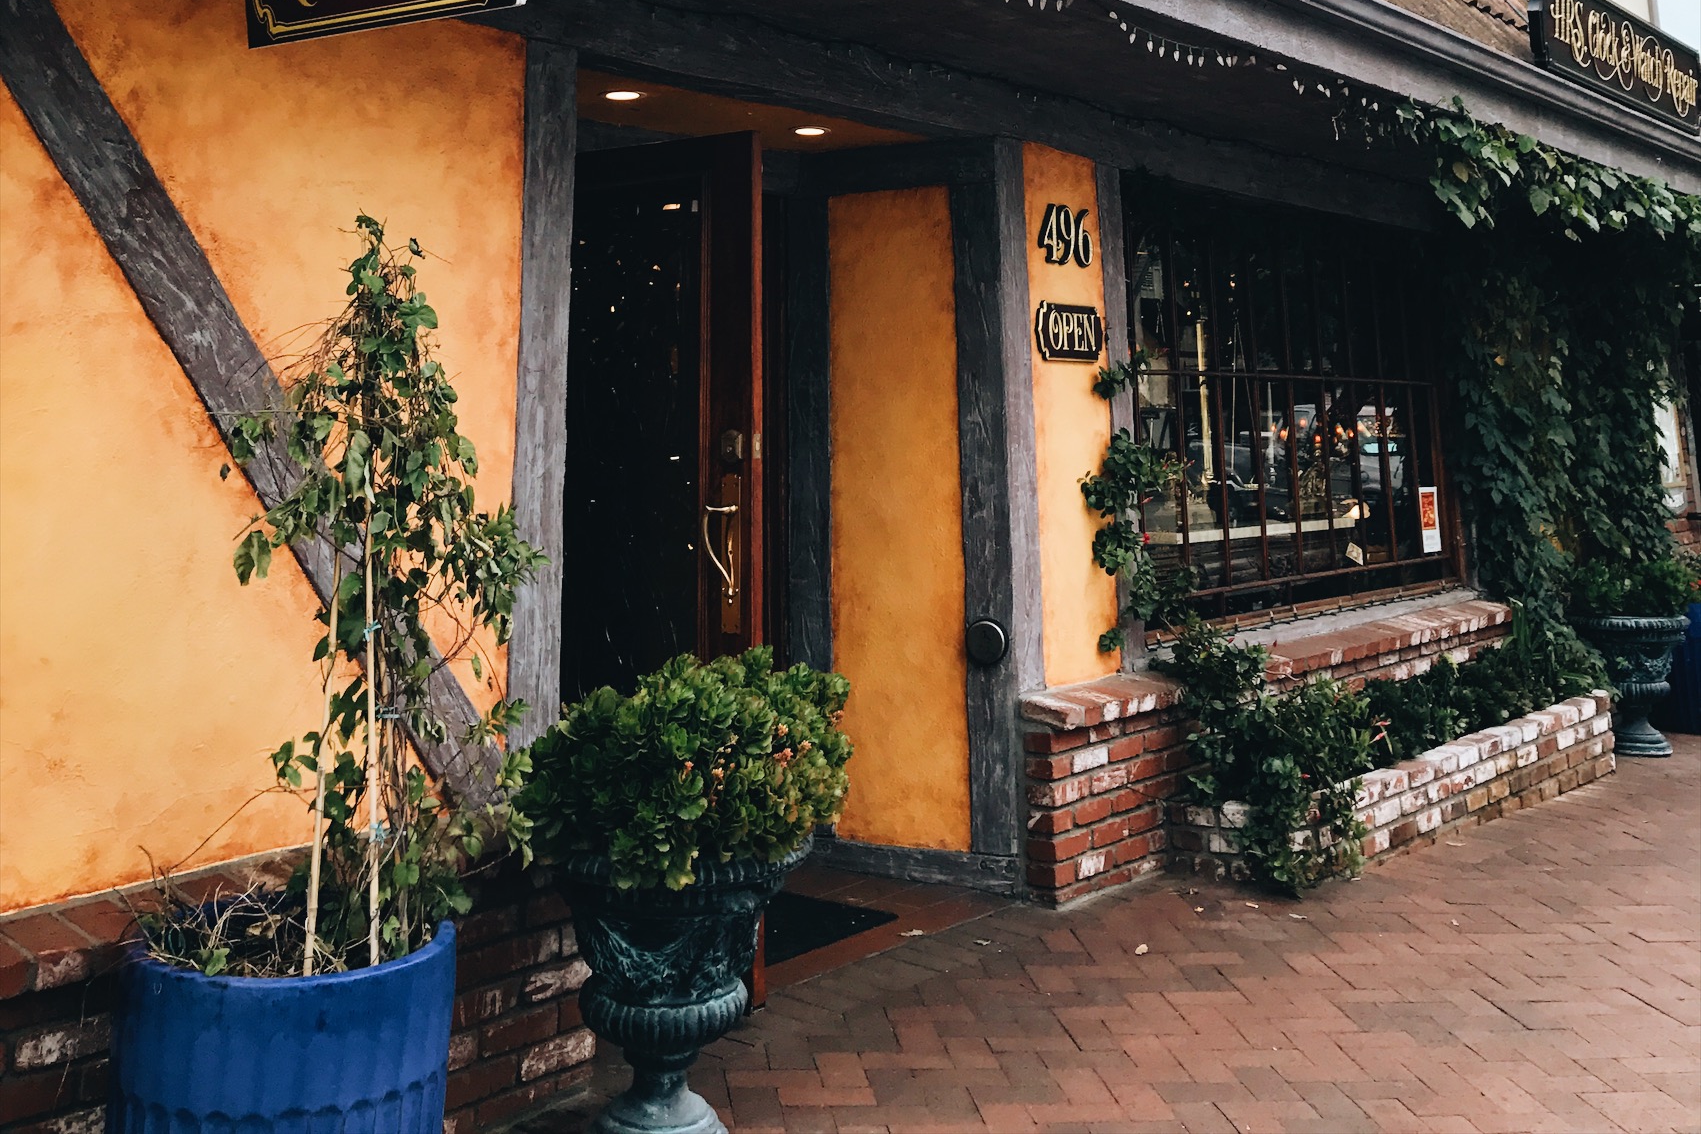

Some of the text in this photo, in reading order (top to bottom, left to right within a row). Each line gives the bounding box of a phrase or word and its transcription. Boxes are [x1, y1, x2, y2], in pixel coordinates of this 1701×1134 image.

[1588, 9, 1620, 81] Clock
[1633, 34, 1663, 102] Watch
[1662, 49, 1698, 117] Repair
[1043, 205, 1094, 266] 496
[1049, 310, 1097, 351] OPEN
